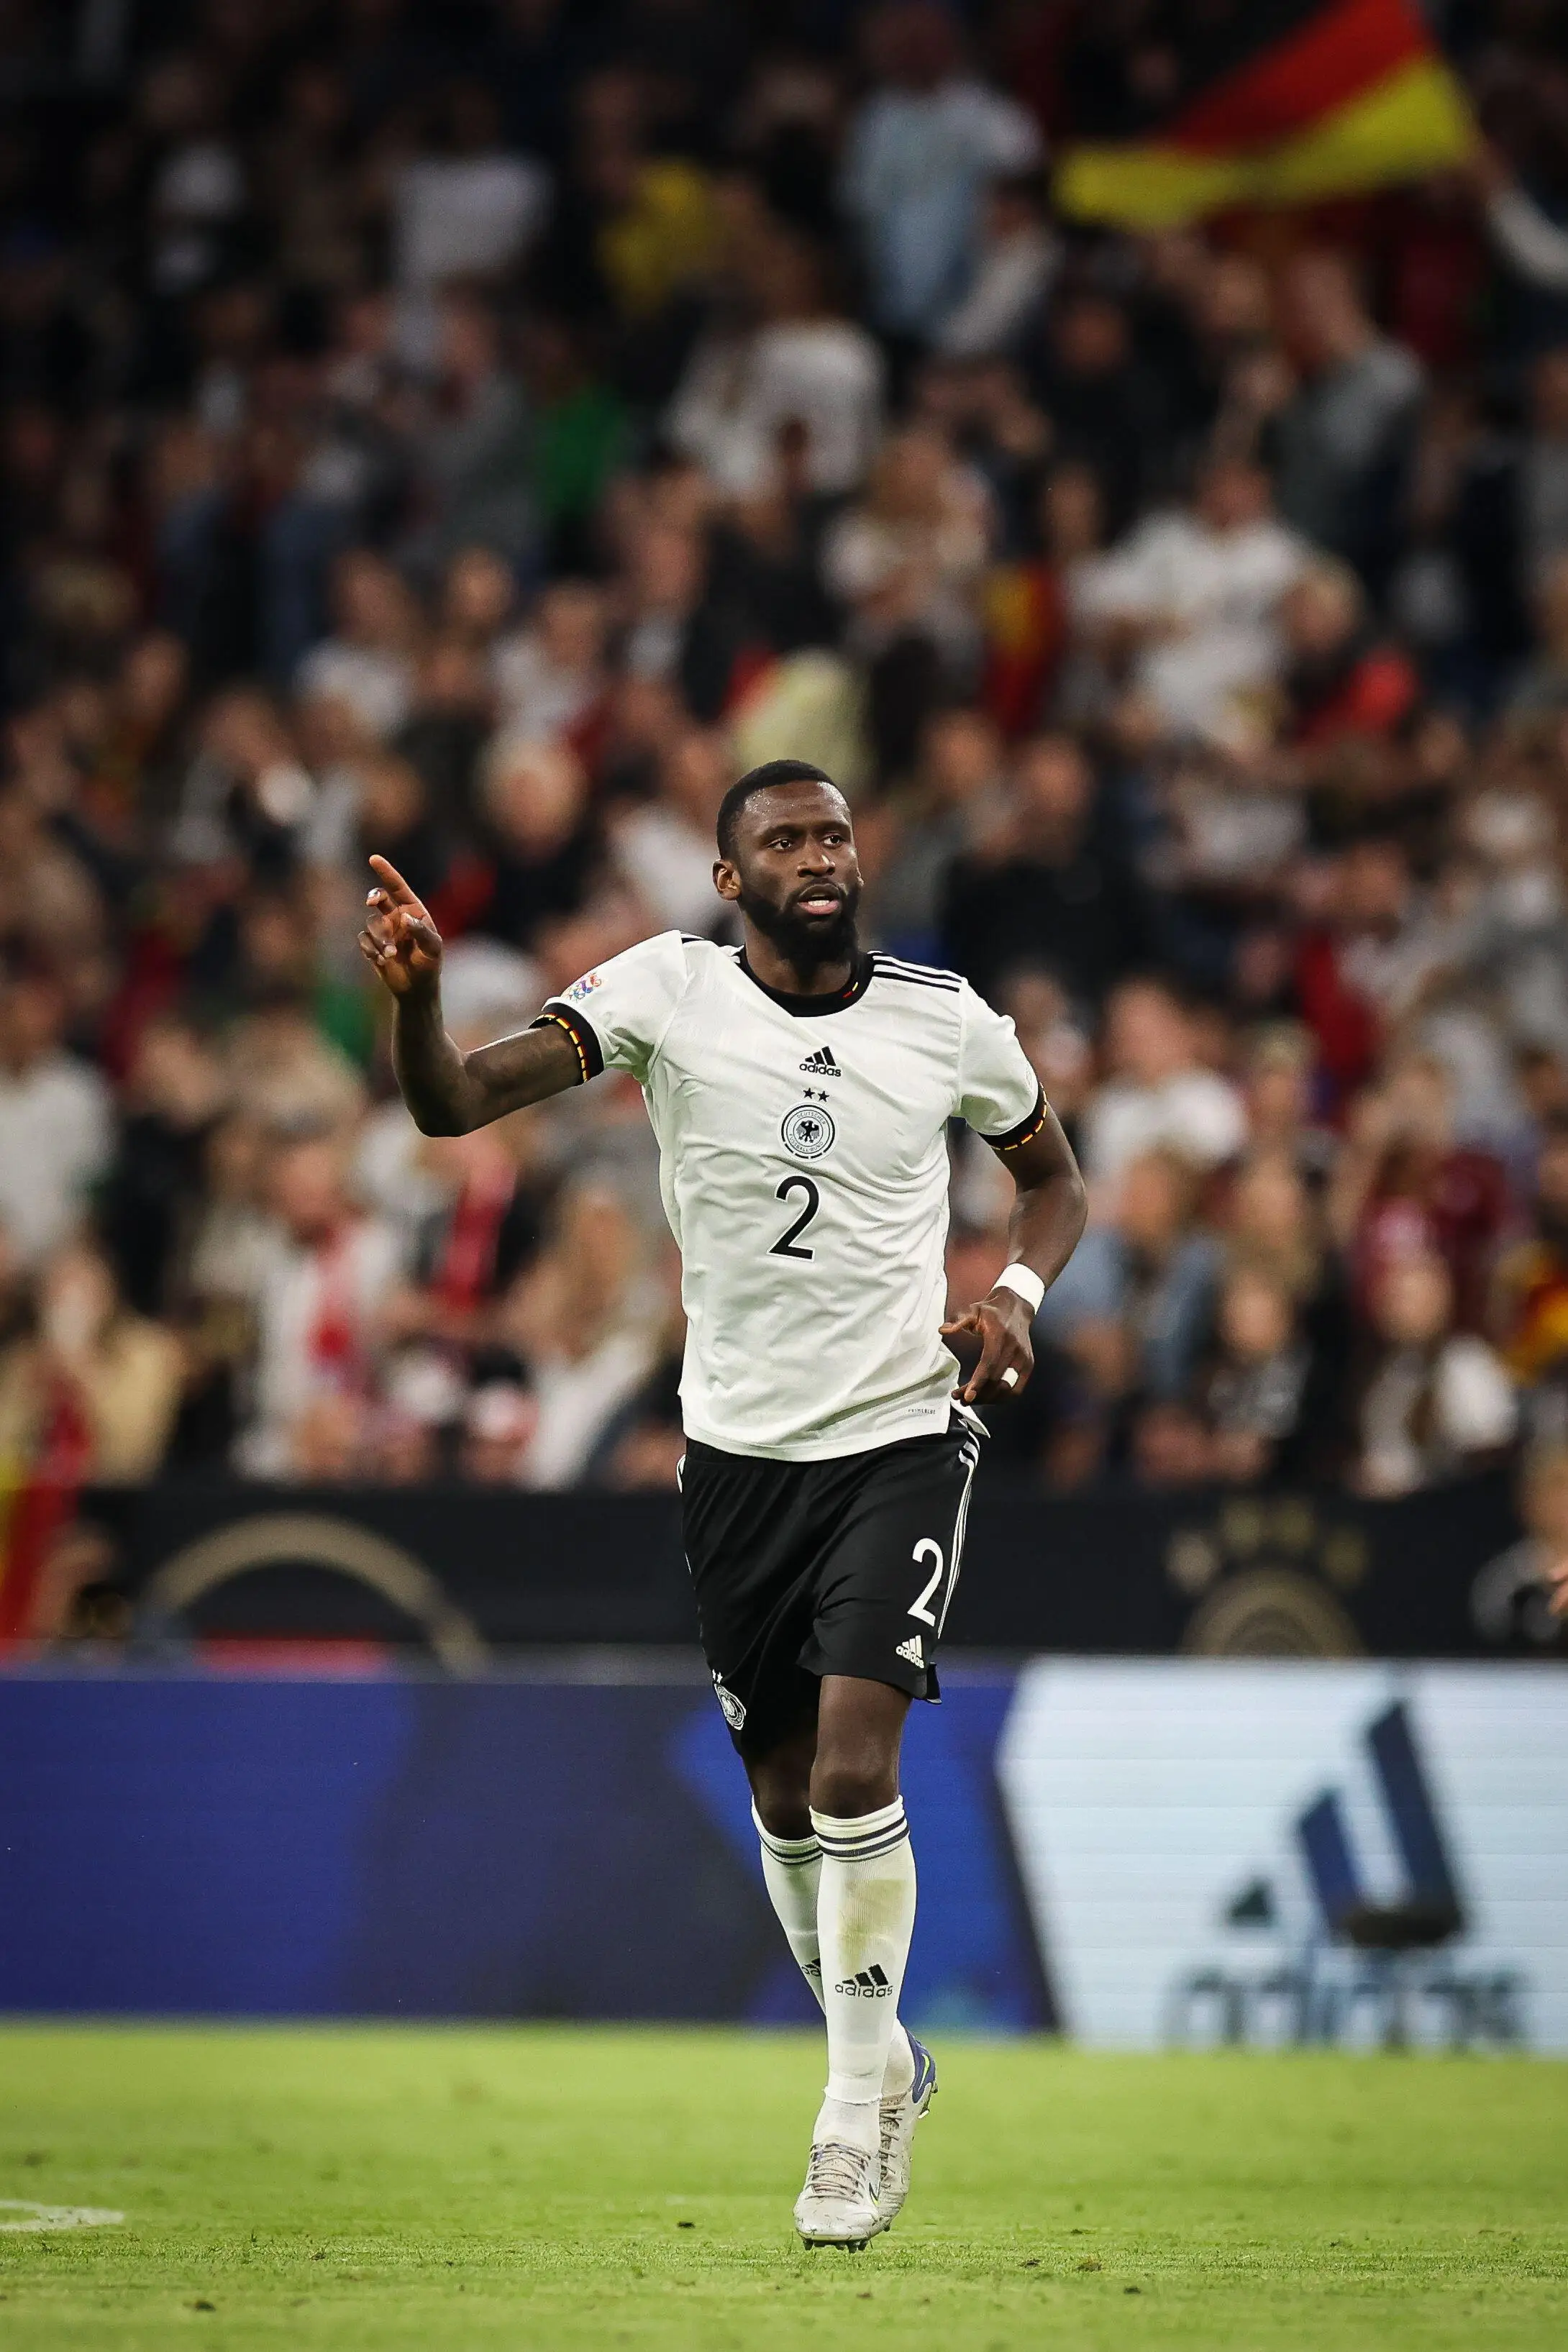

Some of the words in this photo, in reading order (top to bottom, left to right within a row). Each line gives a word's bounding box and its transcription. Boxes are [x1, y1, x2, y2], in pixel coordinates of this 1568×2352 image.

[799, 1063, 842, 1077] adidas
[796, 1111, 826, 1124] DEUTSCHER
[767, 1175, 819, 1259] 2
[907, 1538, 944, 1627] 2
[895, 1646, 925, 1669] adidas
[834, 1983, 893, 1998] adidas
